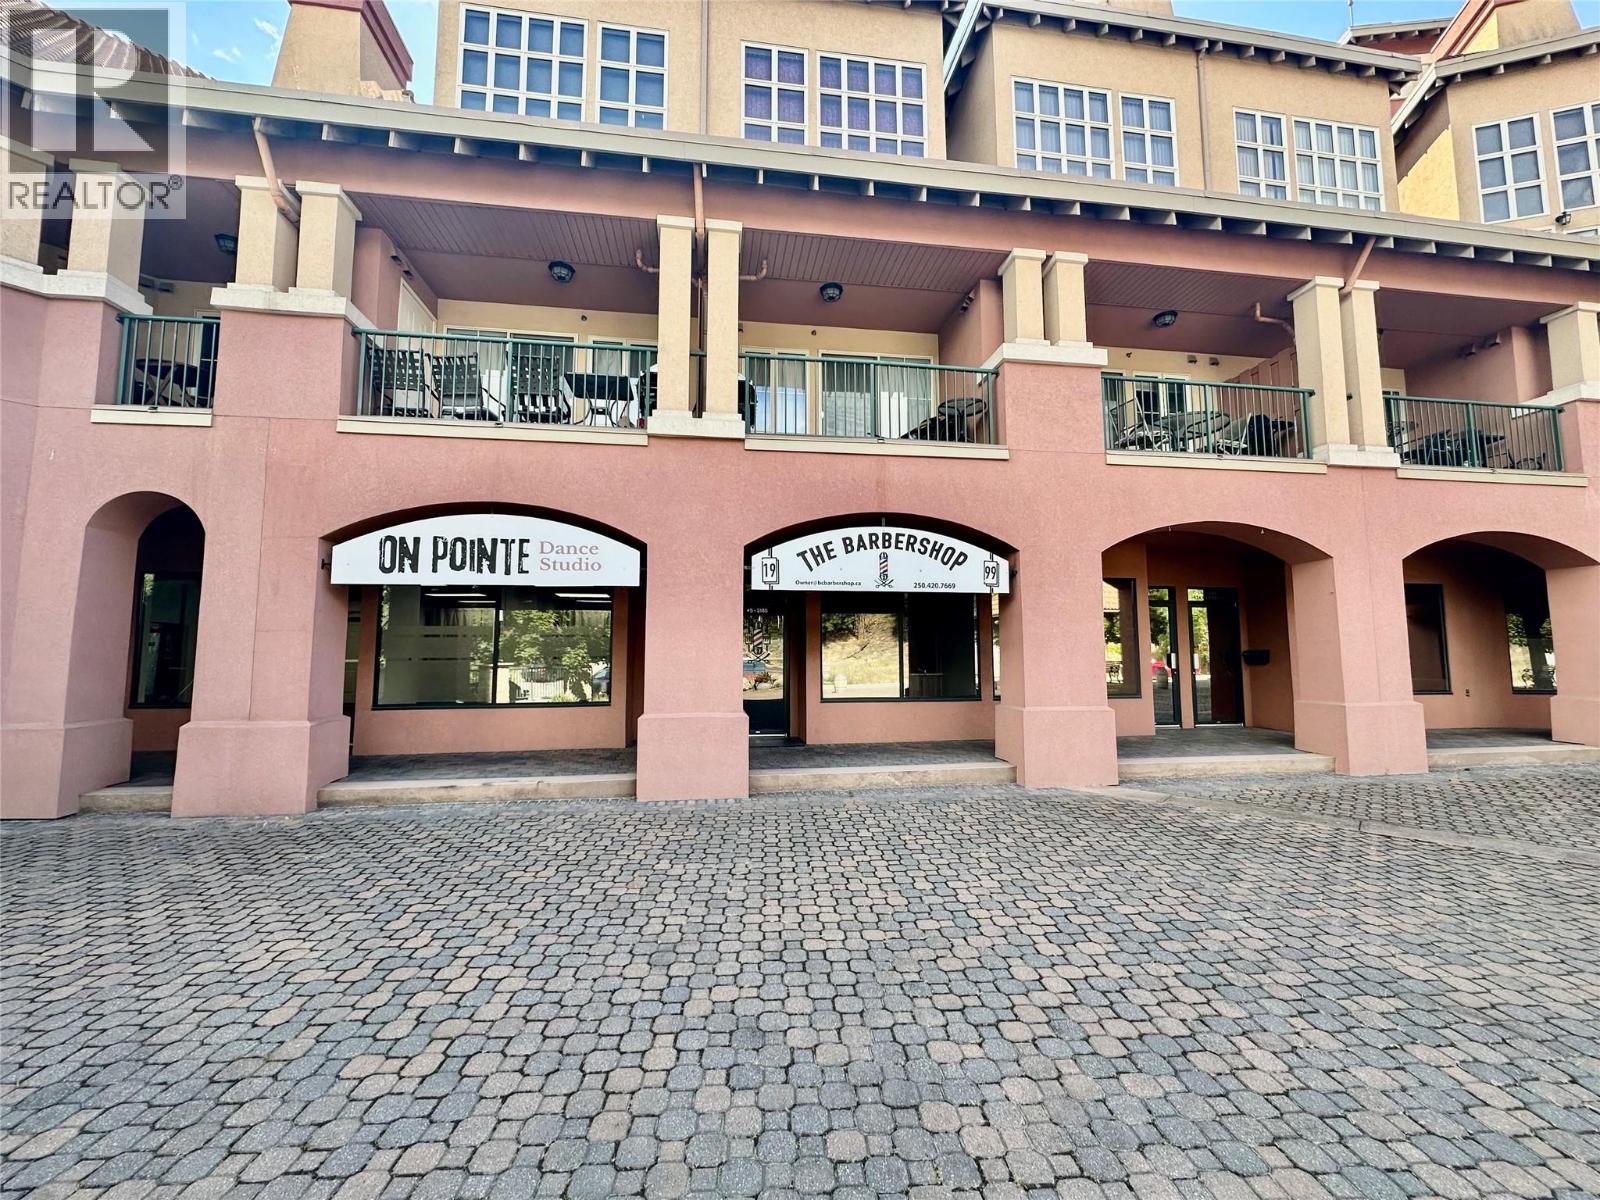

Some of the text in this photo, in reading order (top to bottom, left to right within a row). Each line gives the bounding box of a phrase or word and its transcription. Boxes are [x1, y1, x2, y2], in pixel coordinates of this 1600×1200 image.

[379, 535, 530, 576] ON POINTE
[539, 541, 599, 555] Dance
[796, 532, 969, 572] THE BARBERSHOP
[539, 557, 602, 572] Studio
[763, 563, 776, 578] 19
[984, 565, 997, 580] 99
